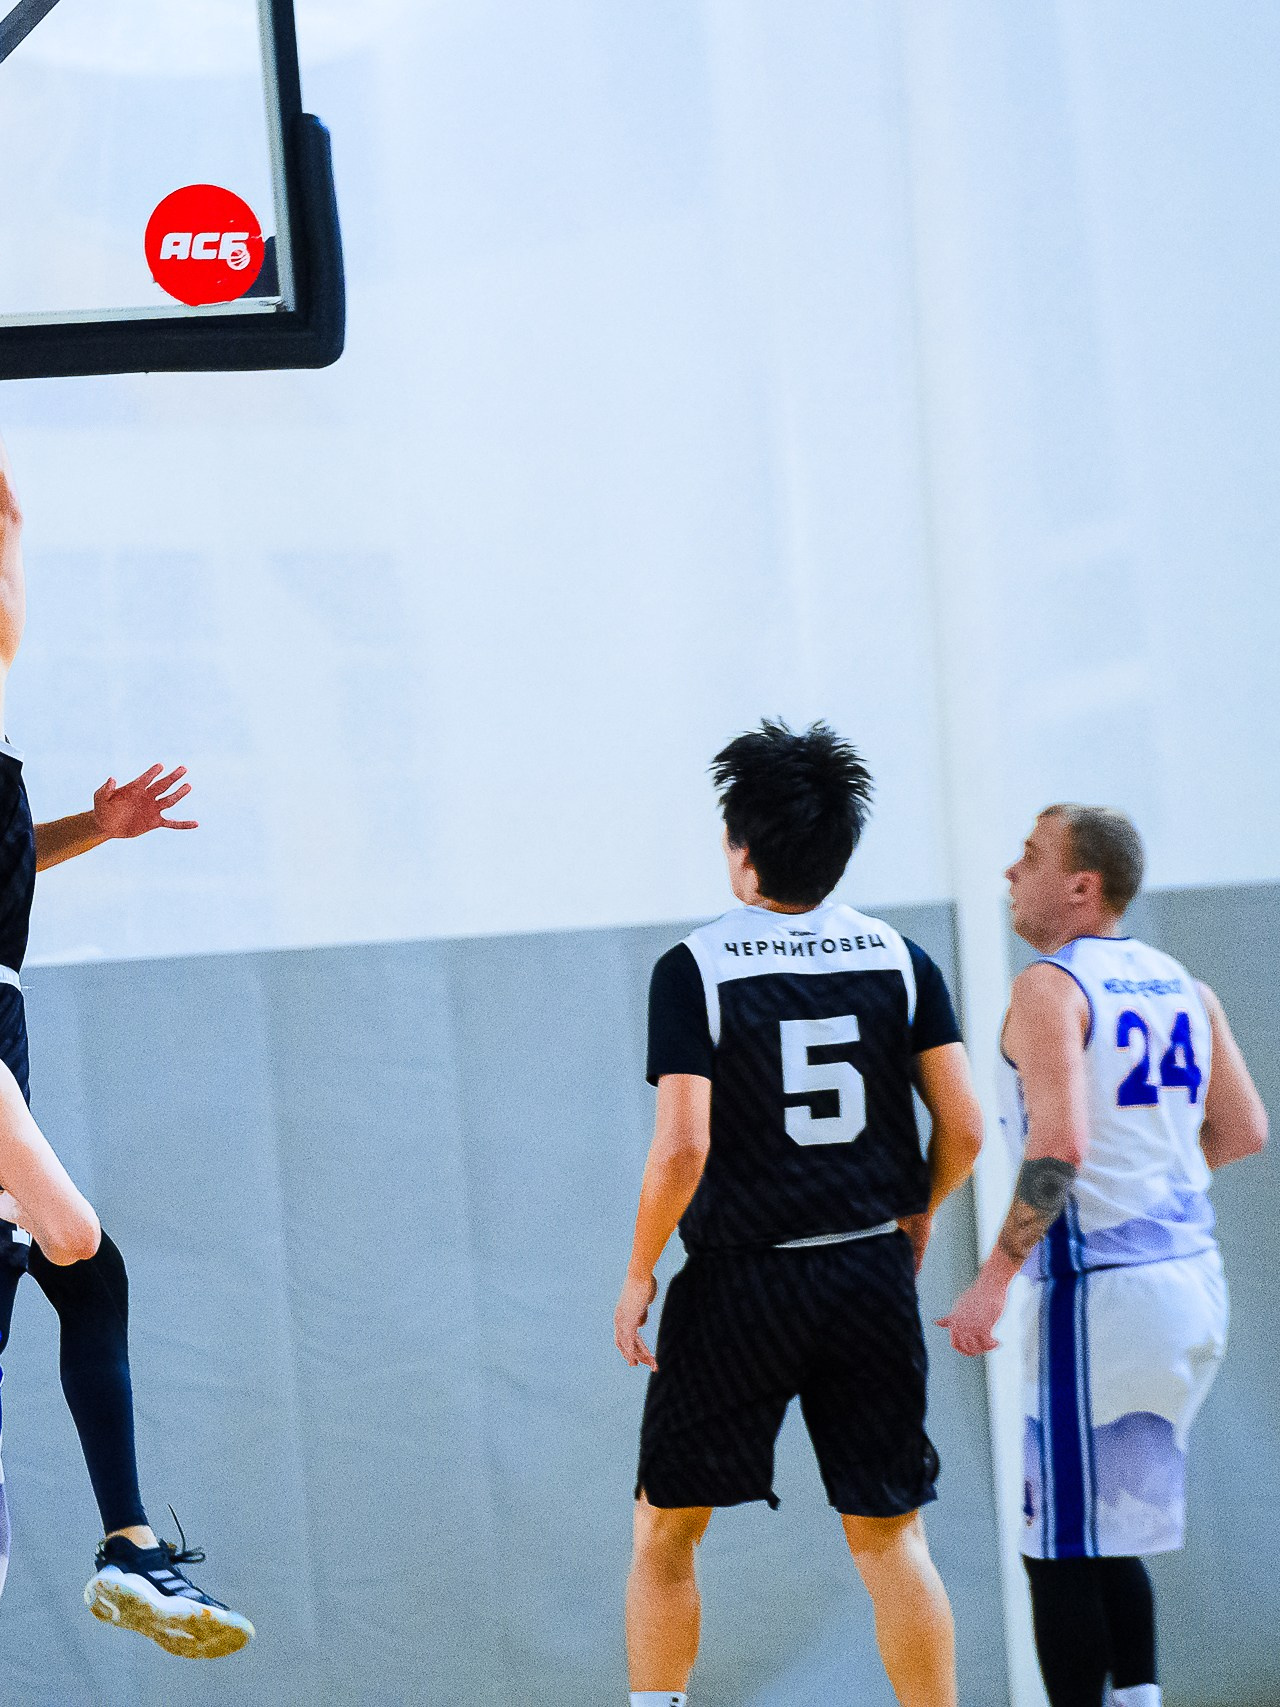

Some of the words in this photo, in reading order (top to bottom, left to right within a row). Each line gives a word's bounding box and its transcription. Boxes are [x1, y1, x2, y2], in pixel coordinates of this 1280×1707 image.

[160, 232, 250, 262] АСБ
[724, 934, 887, 956] ЧЕРНИГОВЕЦ
[779, 1014, 867, 1146] 5
[1115, 1007, 1202, 1110] 24
